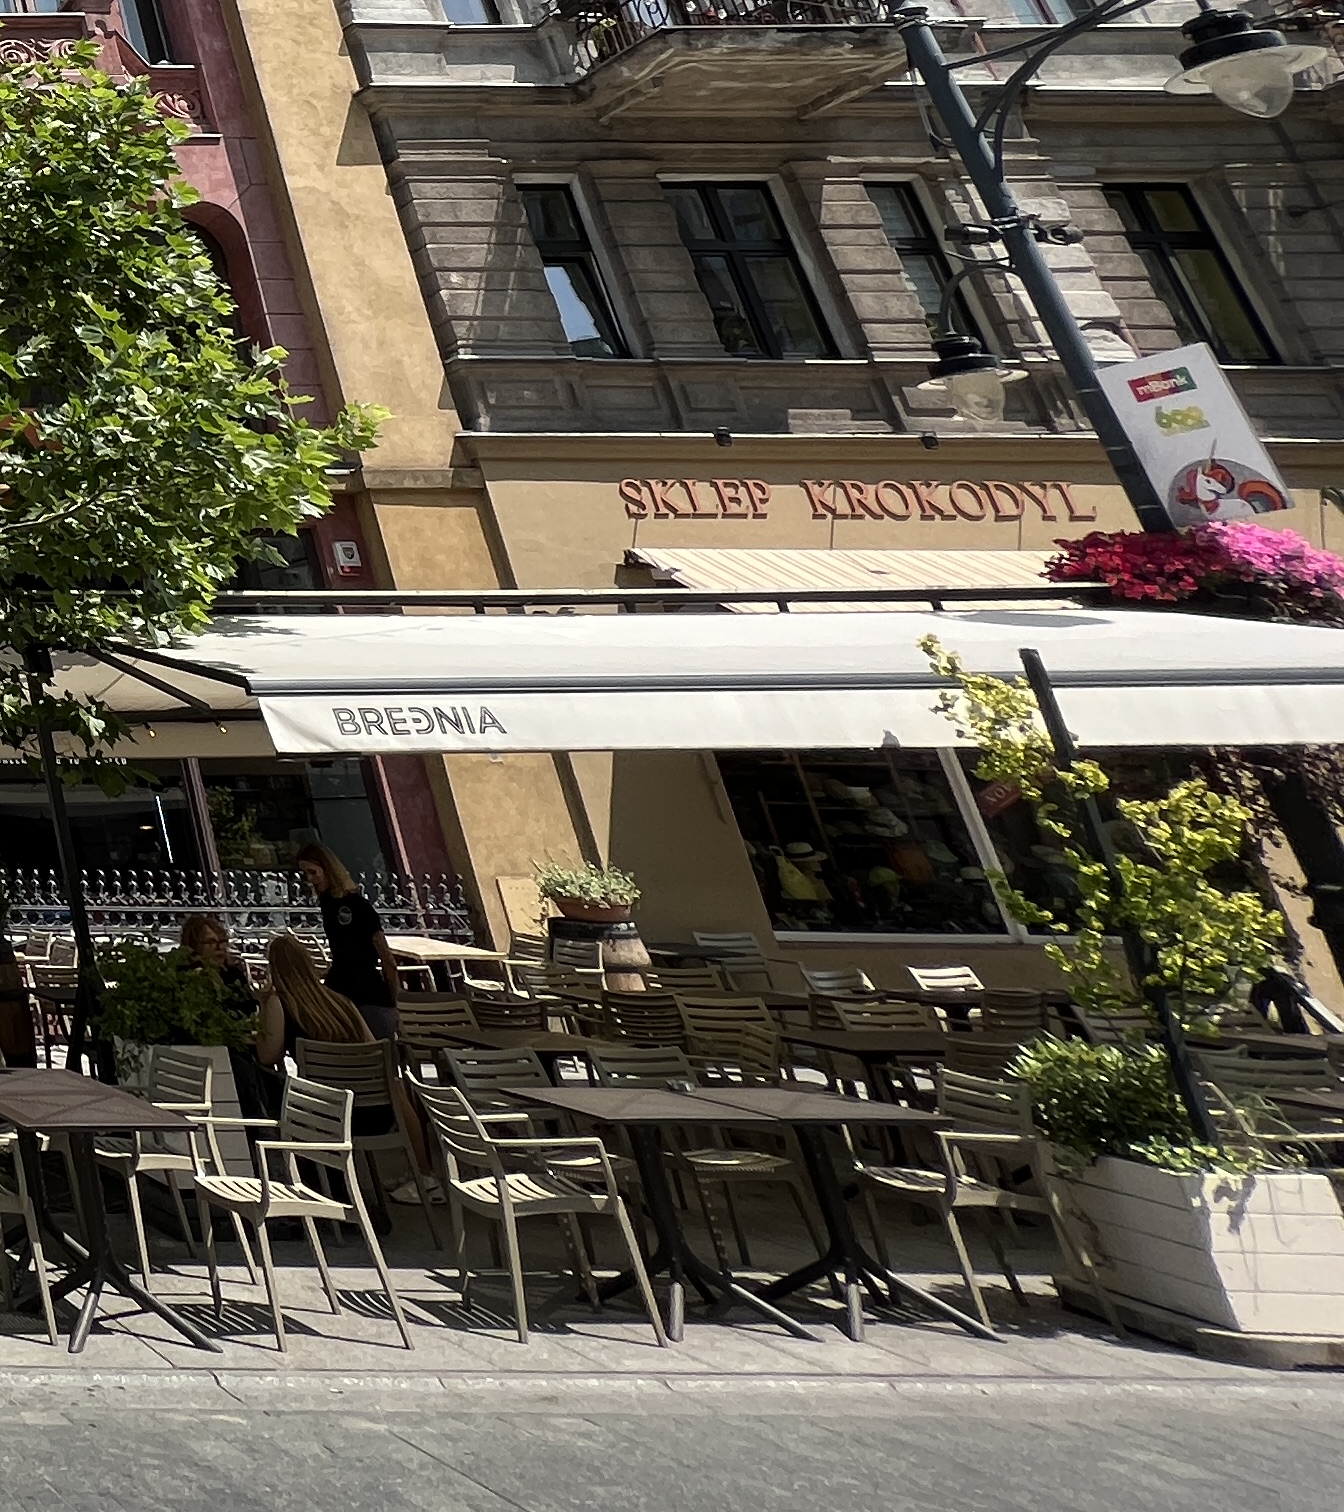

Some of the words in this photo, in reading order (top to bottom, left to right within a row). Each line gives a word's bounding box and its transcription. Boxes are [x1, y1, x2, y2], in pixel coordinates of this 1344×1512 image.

[1136, 375, 1189, 396] mBank
[618, 478, 772, 520] SKLEP
[799, 479, 1098, 522] KROKODYL
